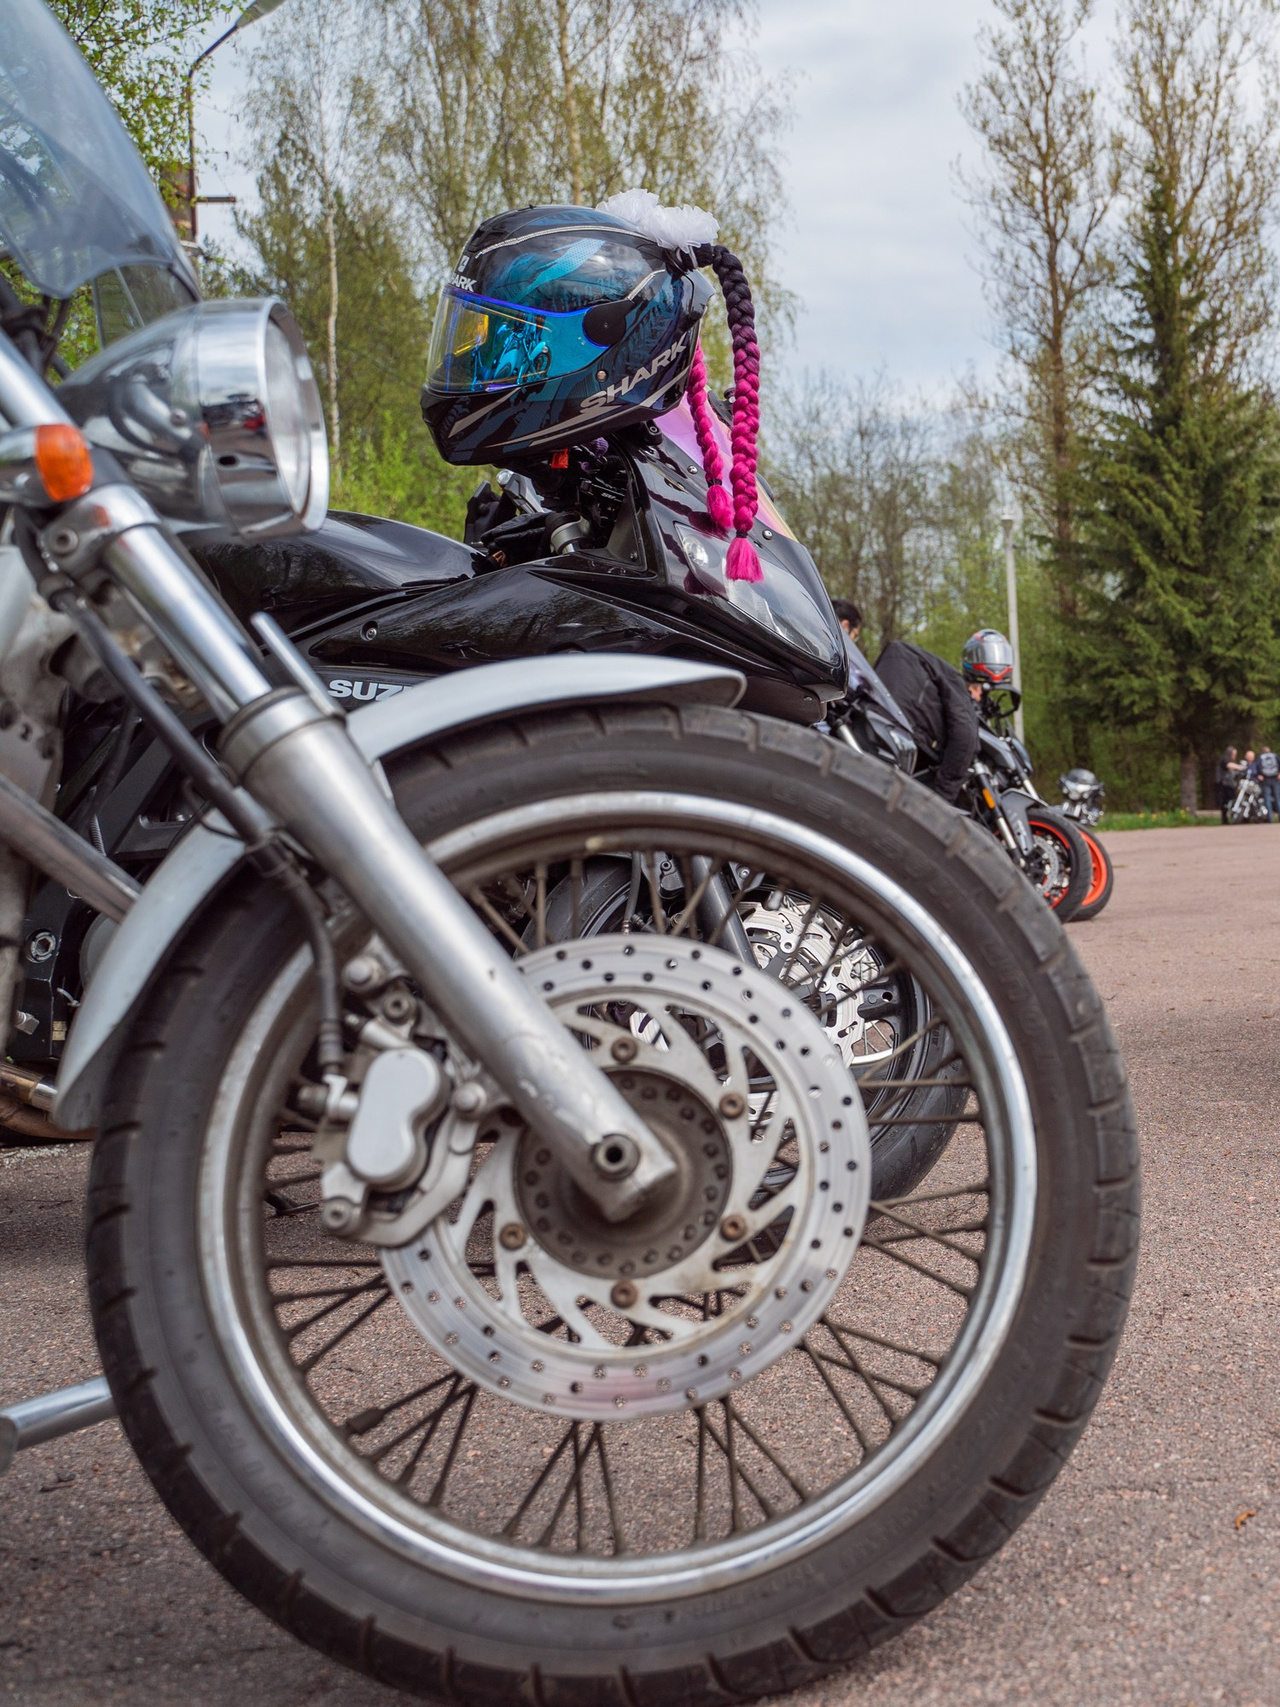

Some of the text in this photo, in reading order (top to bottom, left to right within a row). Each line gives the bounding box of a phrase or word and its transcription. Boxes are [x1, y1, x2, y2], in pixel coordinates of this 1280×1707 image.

[451, 274, 478, 292] ARK
[580, 331, 687, 412] SHARK
[327, 679, 413, 701] SUZ
